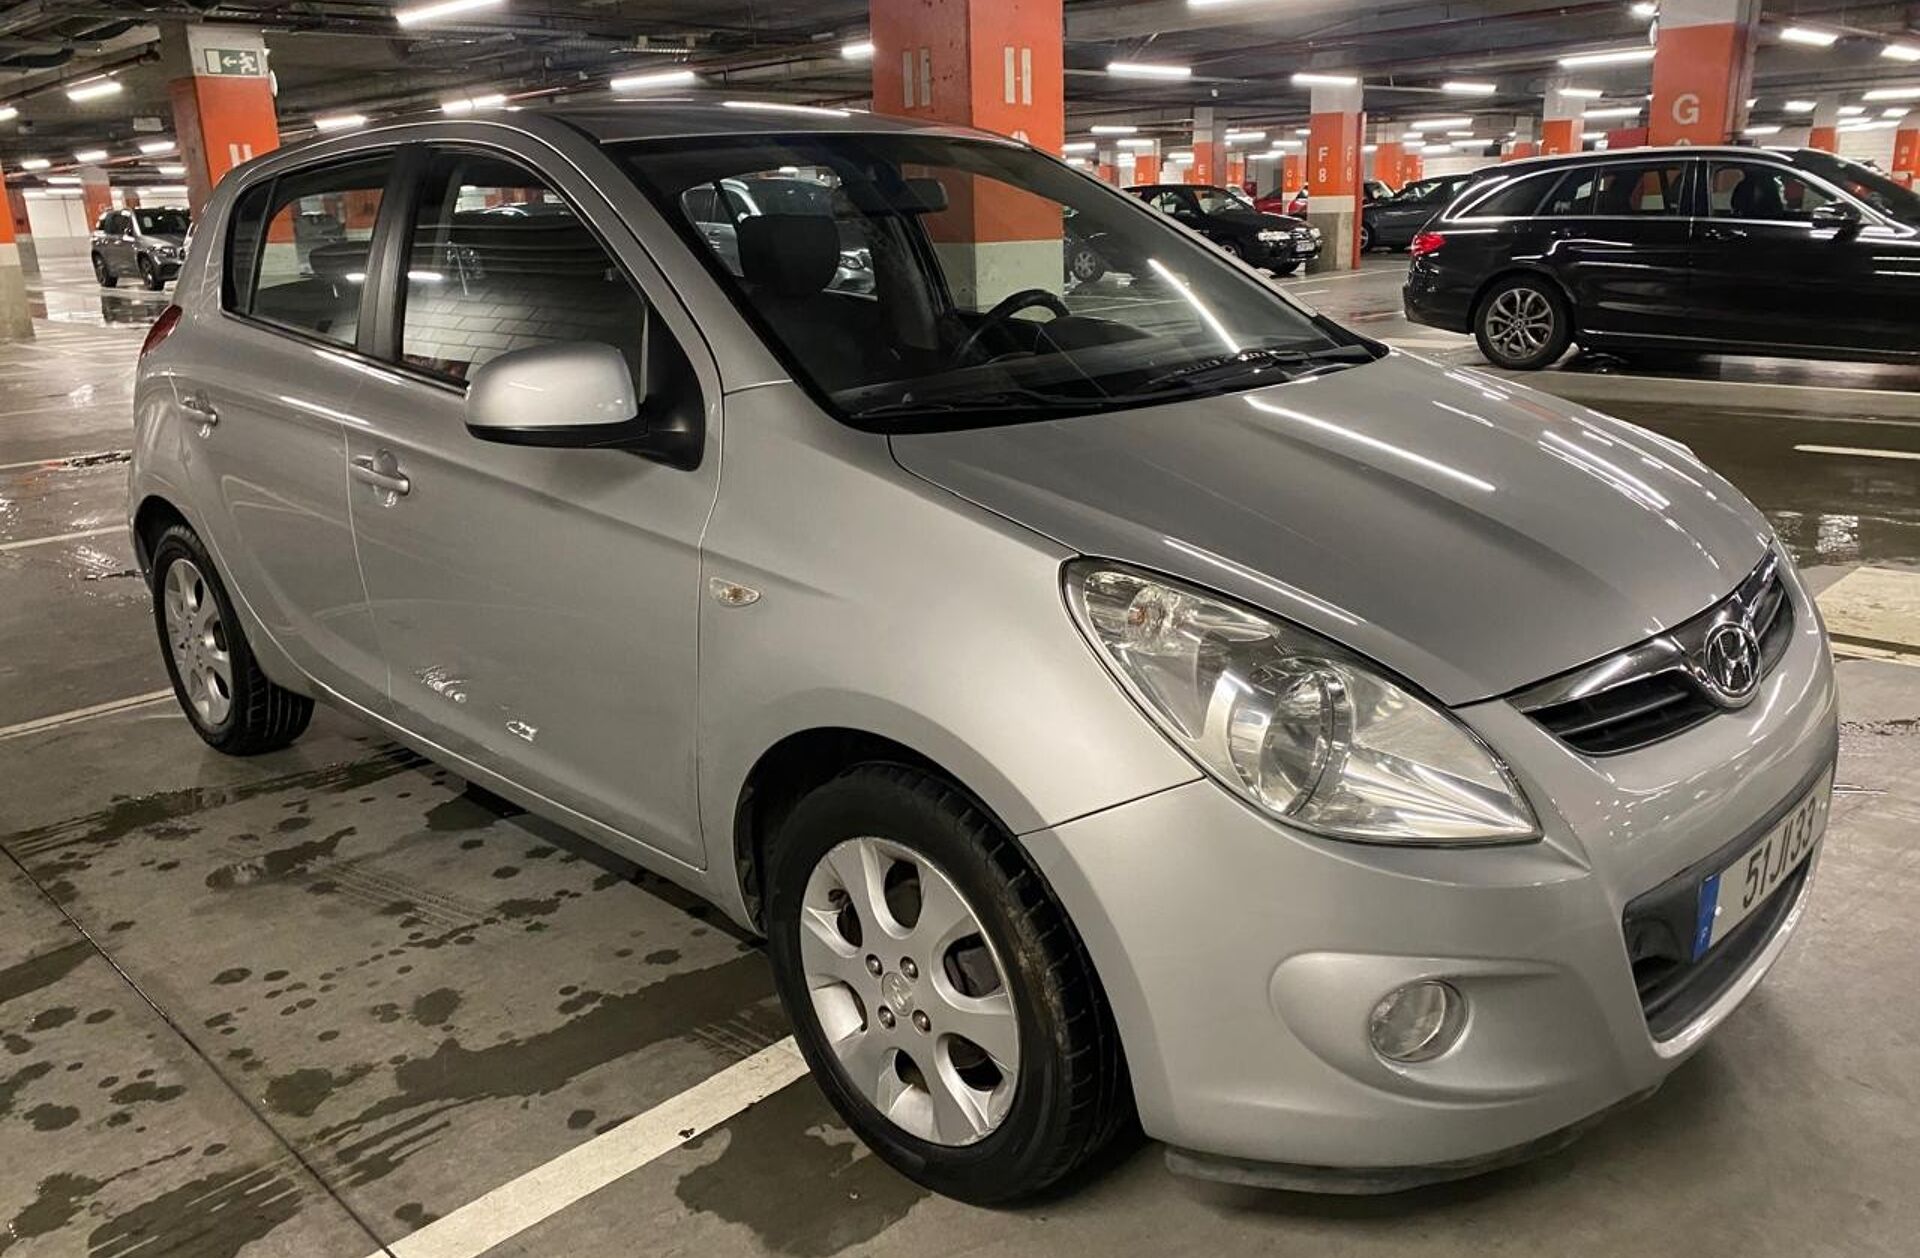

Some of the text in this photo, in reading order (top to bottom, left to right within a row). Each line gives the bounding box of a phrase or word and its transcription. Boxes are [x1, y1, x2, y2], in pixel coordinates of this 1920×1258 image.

[1672, 93, 1699, 125] G
[1319, 146, 1329, 162] F
[1319, 168, 1327, 183] 8
